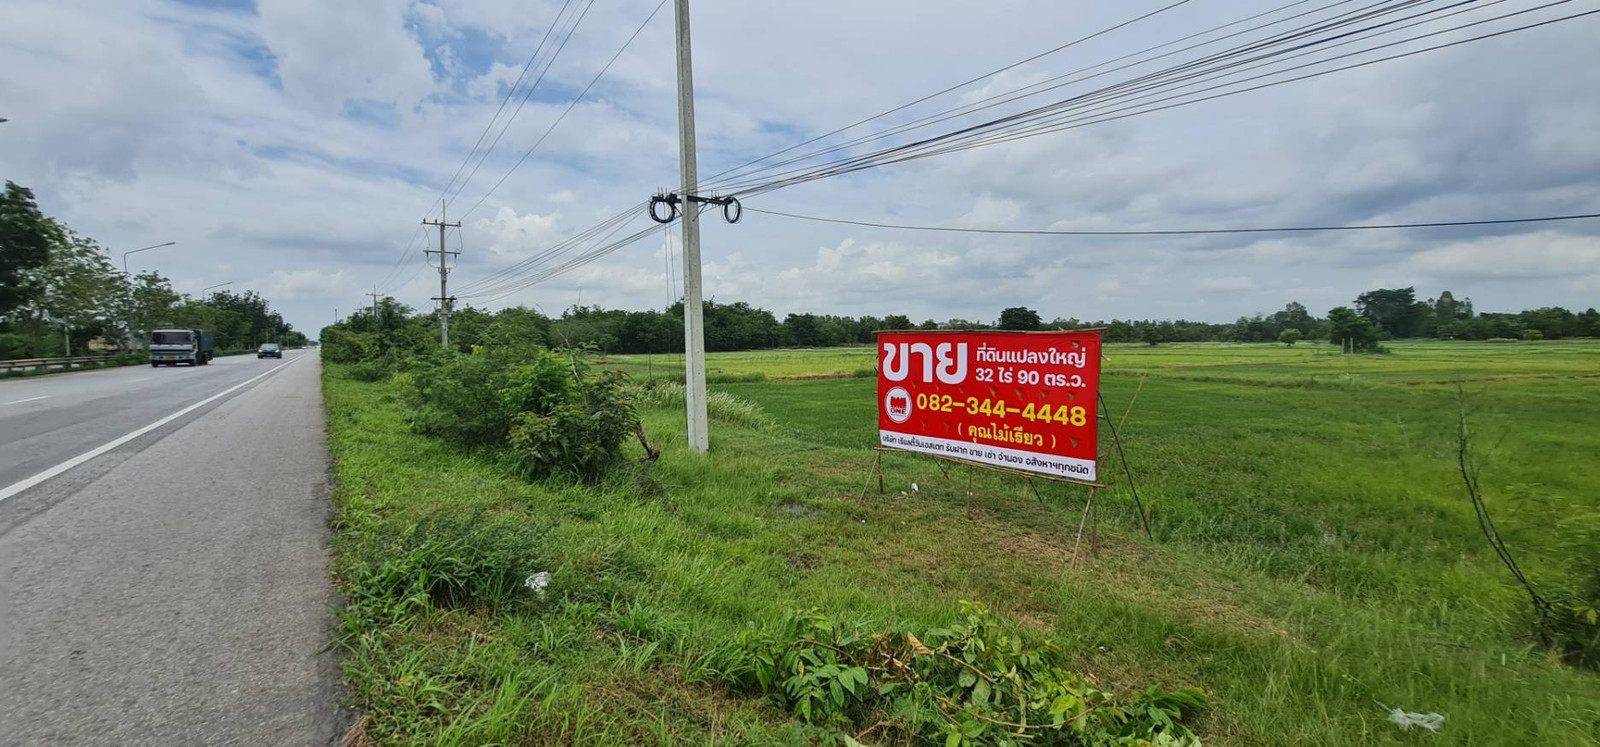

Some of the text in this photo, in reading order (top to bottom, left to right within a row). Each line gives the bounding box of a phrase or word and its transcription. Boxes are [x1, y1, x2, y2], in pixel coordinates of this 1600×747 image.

[882, 342, 968, 385] ขาย
[976, 342, 1087, 369] ที่ดินแปลงใหญ่
[975, 366, 1087, 388] 32 ไร่ 90 ตร.ว.
[890, 407, 906, 415] ONE
[916, 393, 1087, 427] 082-344-4448
[882, 434, 897, 443] บริษัท
[945, 444, 968, 455] รับฝาก
[969, 449, 983, 457] ขาย
[984, 449, 996, 460] เช่า
[998, 451, 1024, 464] จำนอง
[1025, 456, 1089, 475] อสังหาฯทุกชนิด
